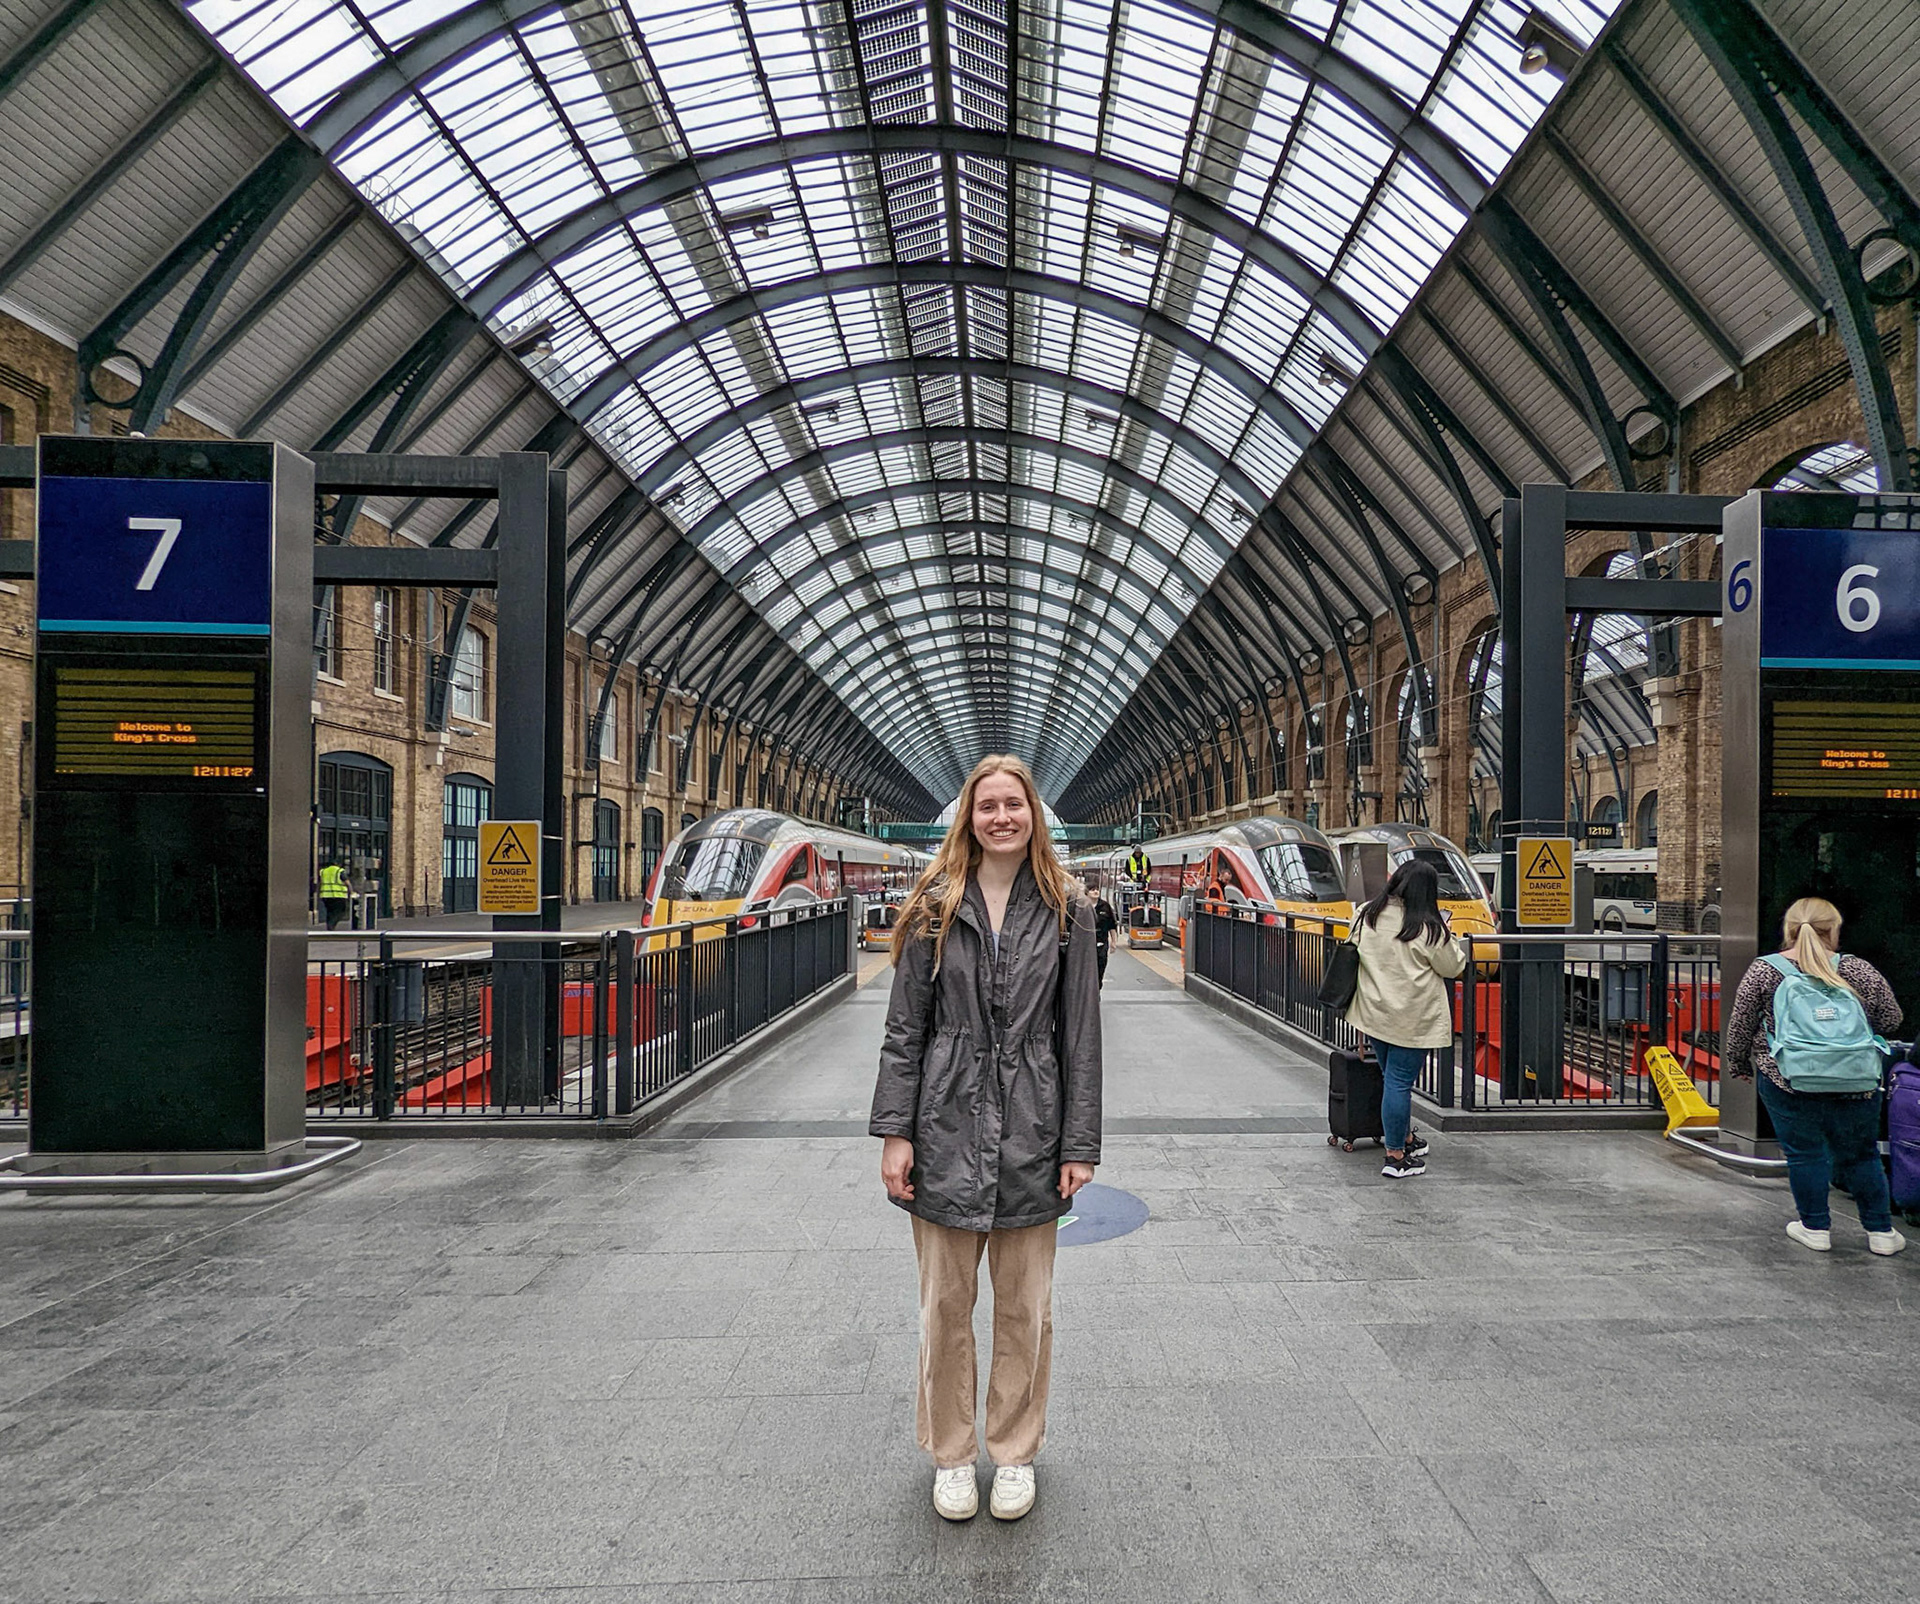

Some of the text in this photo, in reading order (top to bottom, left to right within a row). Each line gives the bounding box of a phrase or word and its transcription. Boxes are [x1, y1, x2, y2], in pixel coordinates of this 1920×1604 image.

[128, 517, 182, 591] 7
[1728, 559, 1752, 613] 6
[1836, 563, 1881, 632] 6
[119, 722, 192, 732] Welcome to
[114, 732, 197, 744] King's Cross
[1826, 750, 1886, 758] Welcome to
[1821, 760, 1890, 768] King's Cross
[193, 766, 253, 776] 12:11:27
